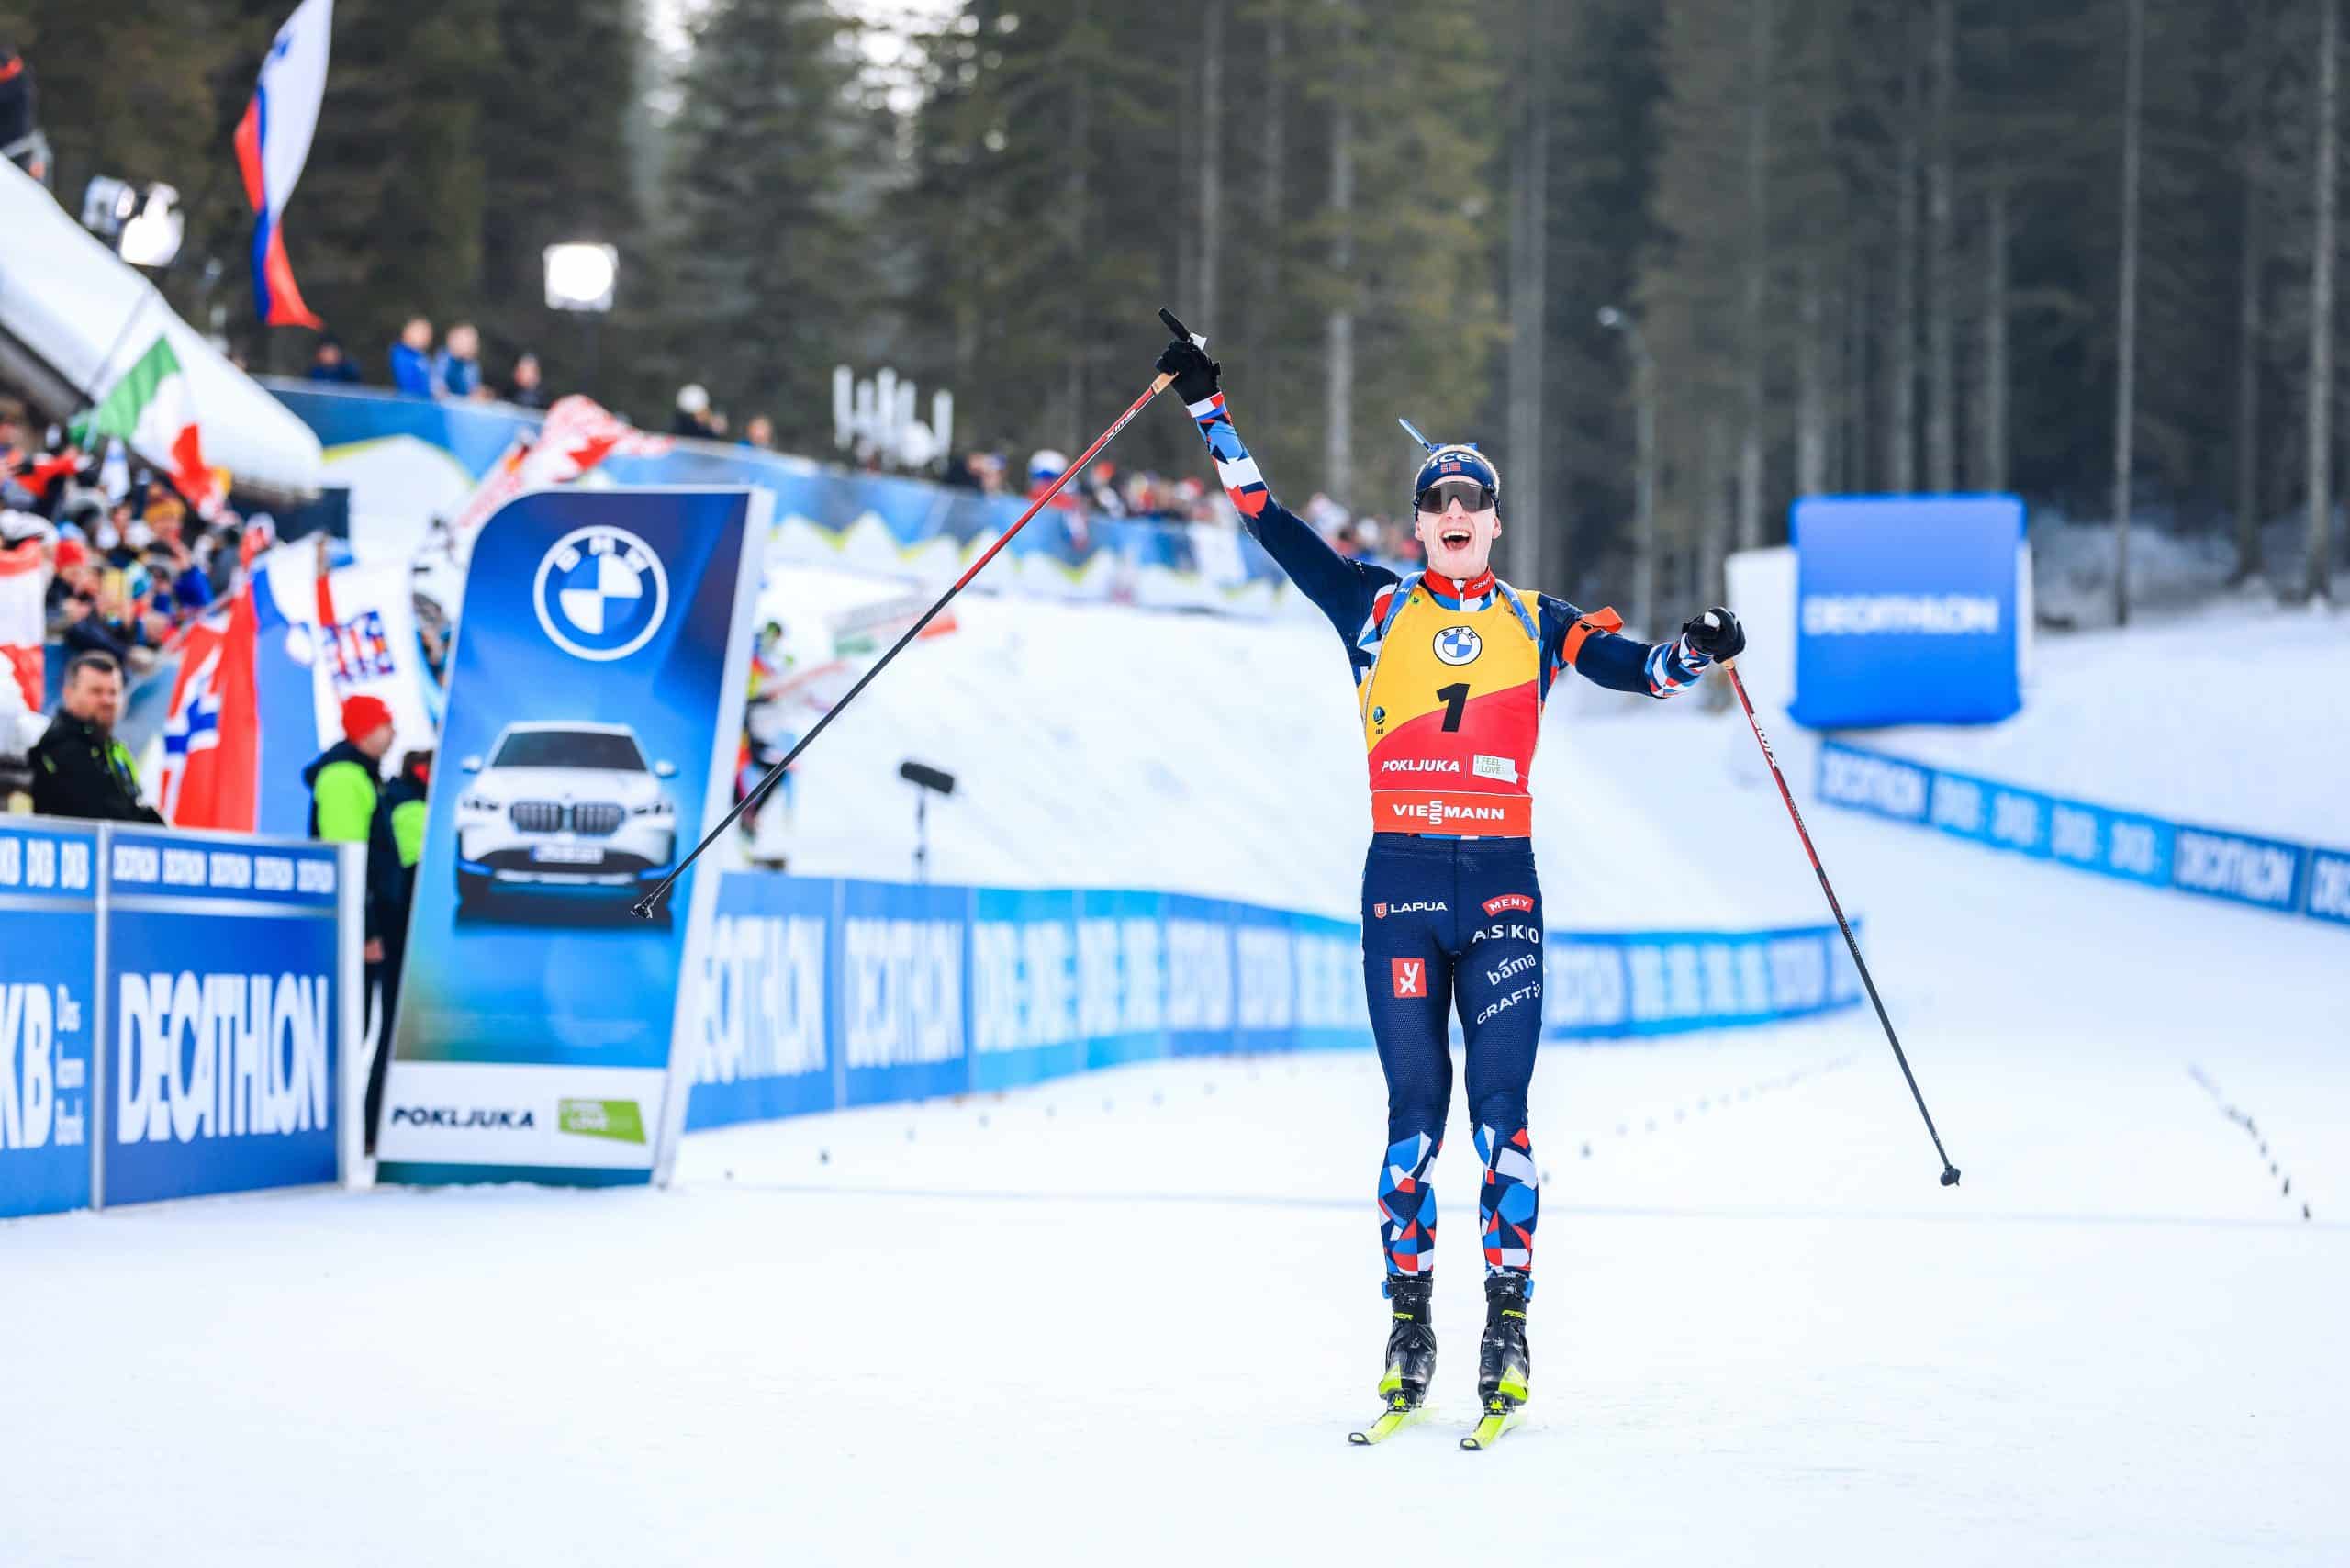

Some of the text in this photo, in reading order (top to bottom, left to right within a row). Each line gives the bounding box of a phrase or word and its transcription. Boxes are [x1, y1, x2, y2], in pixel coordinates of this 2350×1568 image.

[1441, 627, 1477, 641] BMW
[1436, 682, 1471, 733] 1
[1382, 759, 1460, 773] POKLJUKA
[1393, 801, 1505, 825] VIESSMANN
[1390, 902, 1448, 913] LAPUA
[1489, 898, 1529, 912] MENY
[1476, 986, 1532, 1025] CRAFT
[118, 970, 330, 1144] DECATHLON
[392, 1106, 535, 1128] POKLJUKA
